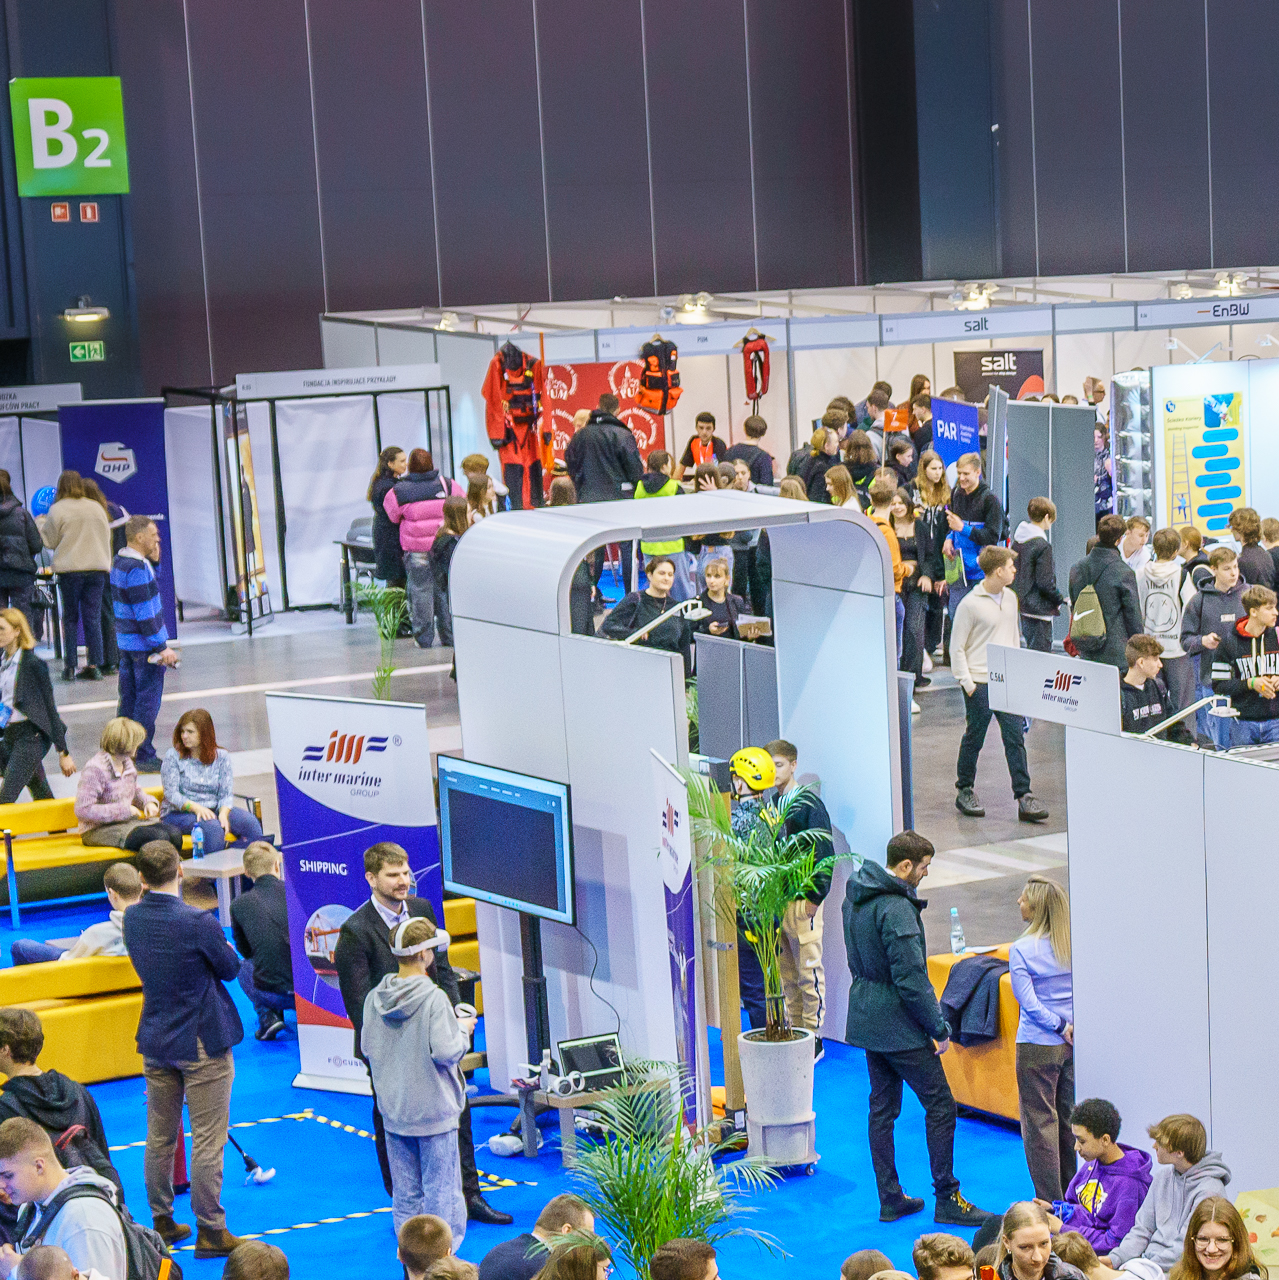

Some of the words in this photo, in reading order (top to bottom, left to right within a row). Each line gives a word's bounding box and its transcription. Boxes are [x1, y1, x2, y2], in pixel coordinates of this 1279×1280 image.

[28, 97, 112, 170] B2
[1212, 304, 1250, 317] EnBW
[964, 317, 989, 332] salt
[981, 353, 1017, 371] salt
[303, 380, 330, 388] FUNDACJA
[21, 402, 40, 410] PRACY
[937, 420, 957, 440] PAR
[102, 463, 130, 473] OHP
[298, 765, 330, 785] inter
[332, 771, 383, 789] marine
[350, 788, 380, 798] GROUP
[299, 858, 348, 877] SHIPPING
